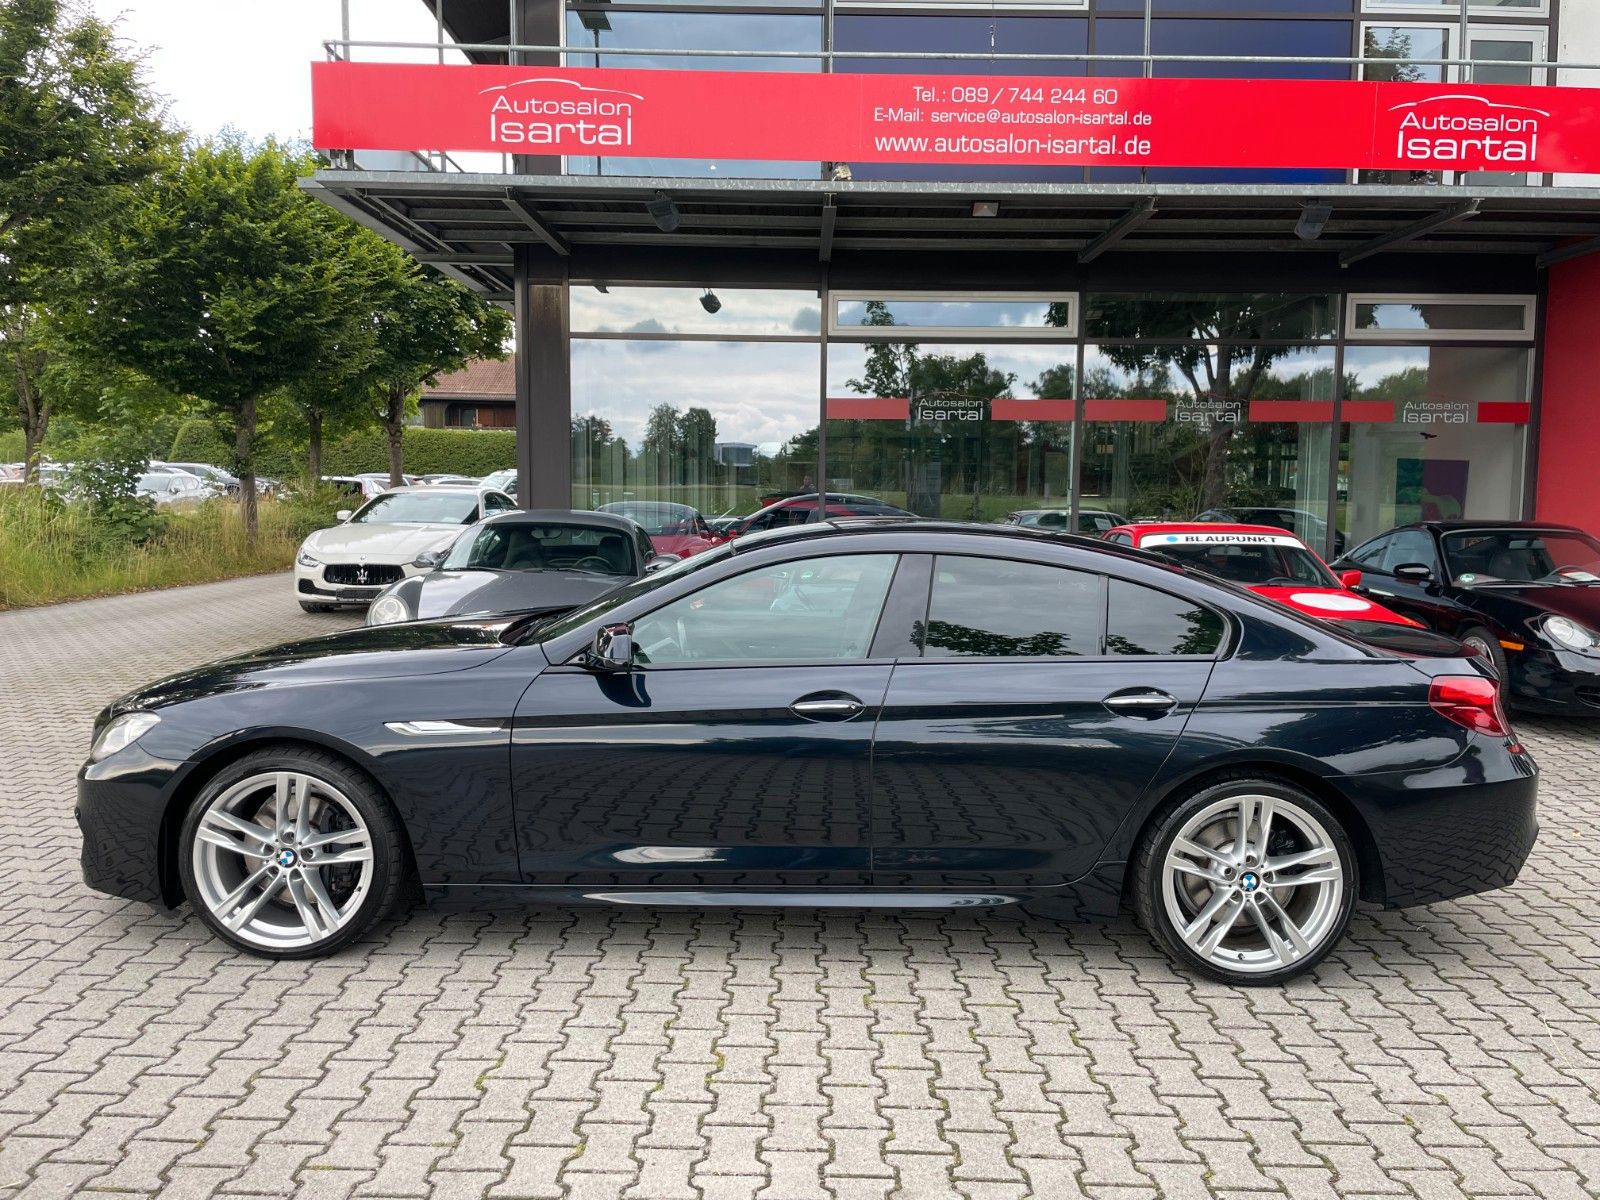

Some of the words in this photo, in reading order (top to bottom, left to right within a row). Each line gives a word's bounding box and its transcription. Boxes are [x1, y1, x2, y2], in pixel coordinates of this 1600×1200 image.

[913, 86, 947, 102] Tel.:
[951, 87, 989, 104] 089
[991, 87, 1004, 104] /
[1008, 87, 1044, 103] 744
[1050, 88, 1087, 104] 244
[1092, 89, 1118, 104] 60
[491, 95, 632, 116] Autosalon
[874, 107, 924, 122] E-Mail:
[930, 109, 1152, 126] service@autosalon-isartal.de
[1400, 112, 1538, 133] Autosalon
[490, 114, 632, 145] Isartal
[875, 134, 1151, 155] www.autosalon-isartal.de
[1396, 131, 1537, 161] Isartal
[919, 399, 983, 408] Autosalon
[1176, 399, 1241, 409] Autosalon
[1404, 401, 1469, 410] Autosalon
[918, 407, 983, 420] Isartal
[1174, 409, 1241, 422] Isartal
[1402, 410, 1469, 423] Isartal
[1185, 535, 1277, 543] BLAUPUNKT
